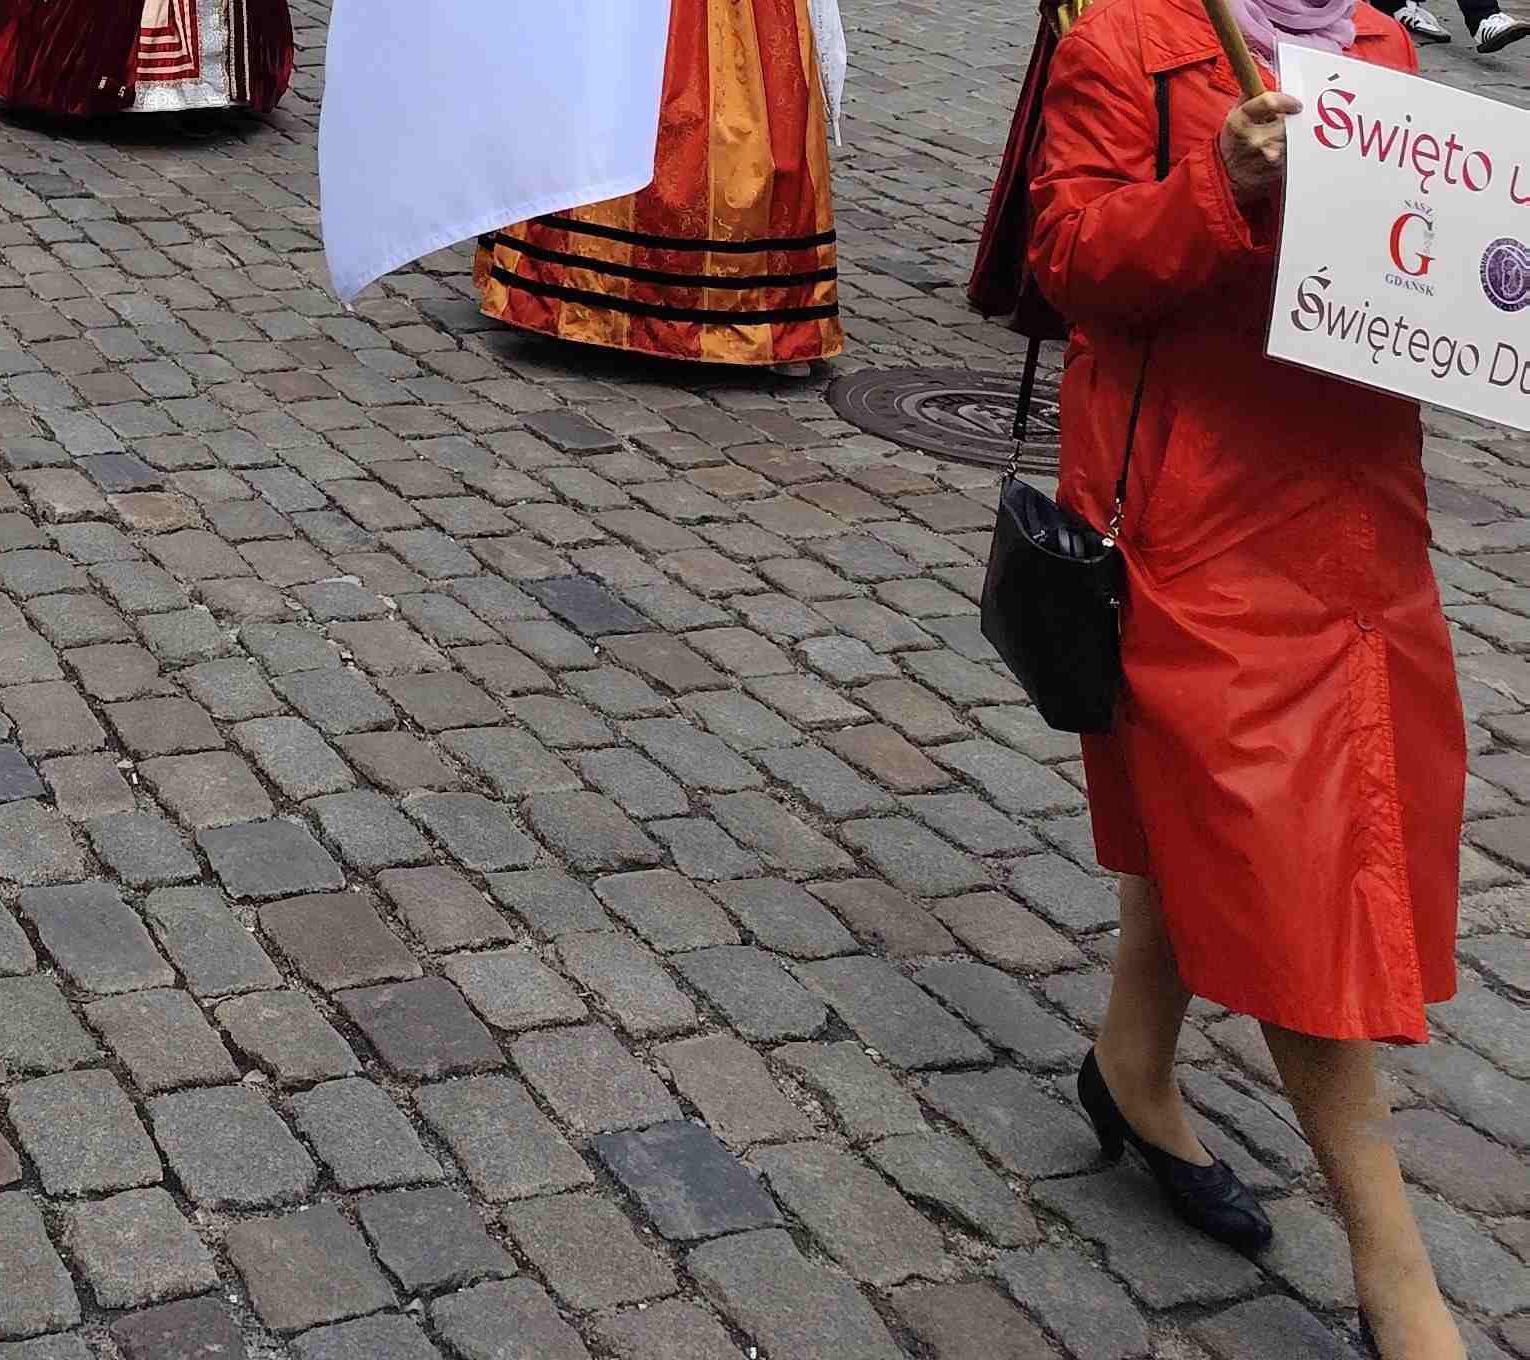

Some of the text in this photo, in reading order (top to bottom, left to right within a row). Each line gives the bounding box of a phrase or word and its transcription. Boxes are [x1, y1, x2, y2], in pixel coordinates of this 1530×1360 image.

[1313, 72, 1493, 195] Święto
[1404, 199, 1434, 217] NASZ
[1290, 265, 1480, 379] Świętego
